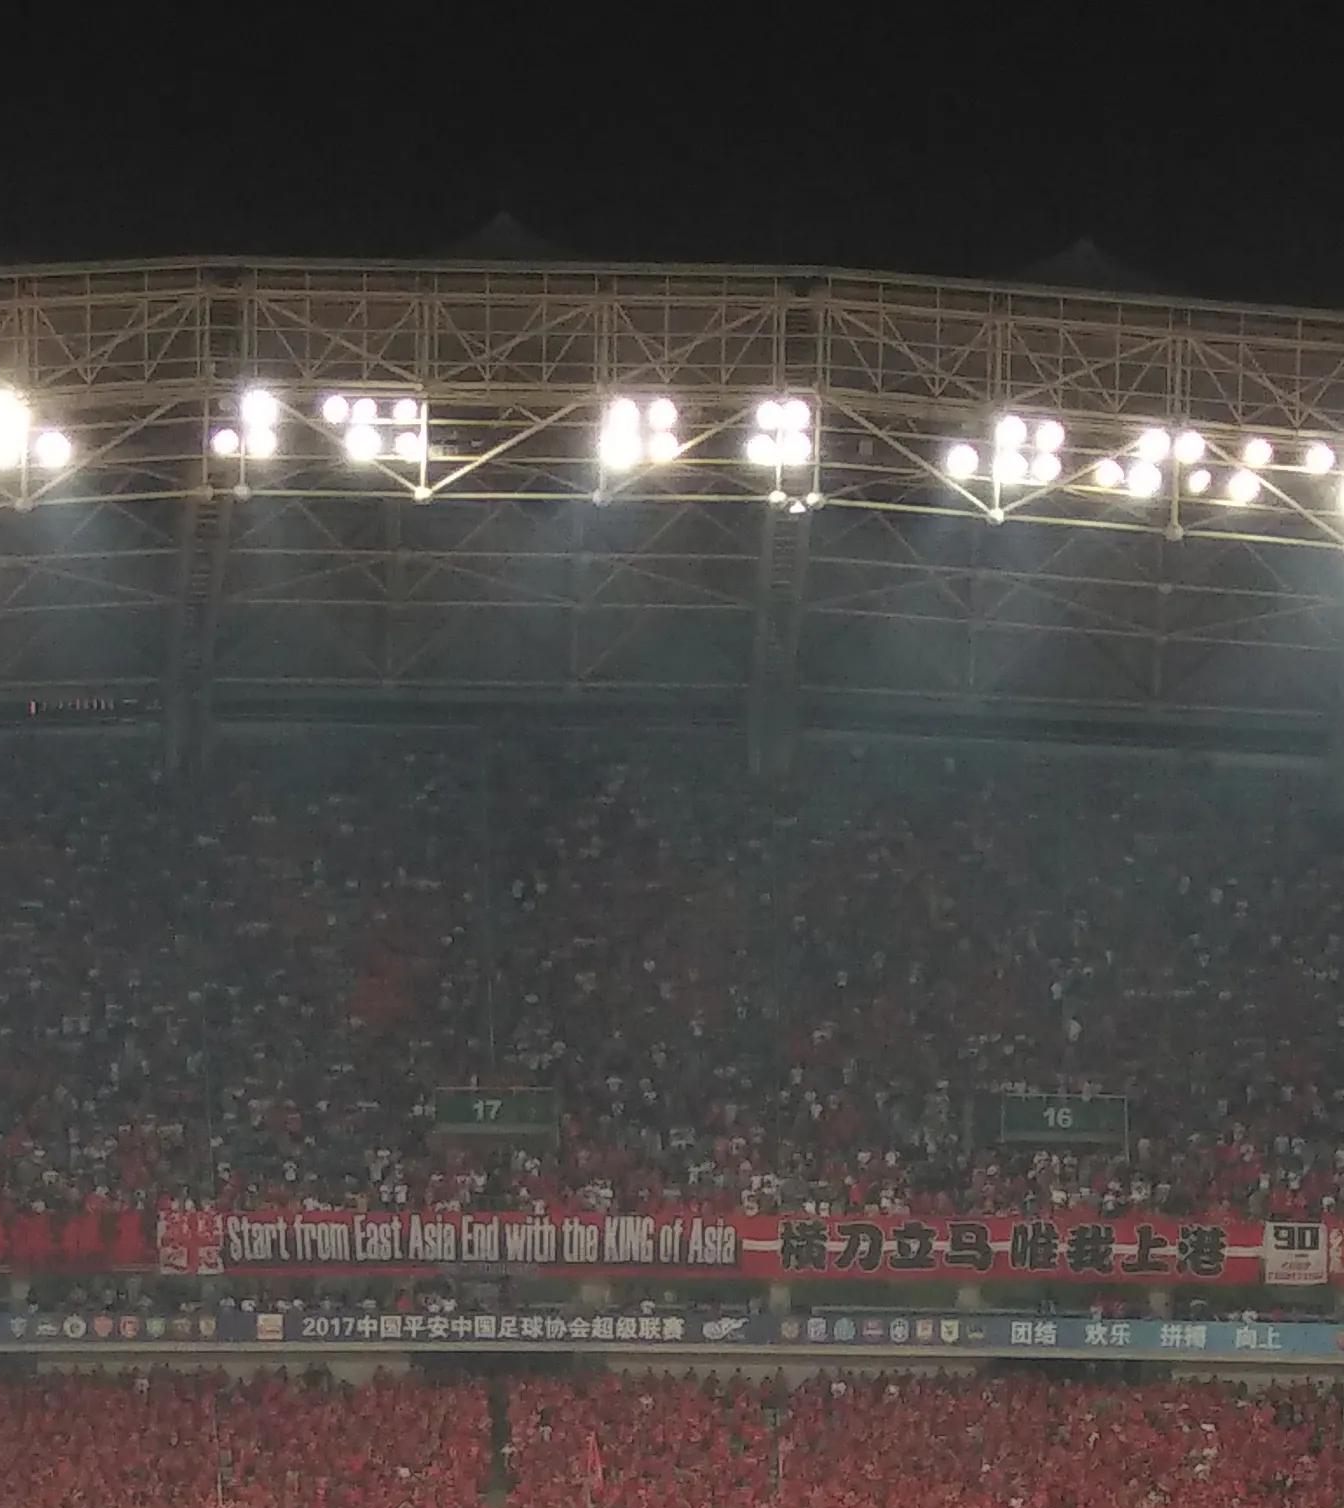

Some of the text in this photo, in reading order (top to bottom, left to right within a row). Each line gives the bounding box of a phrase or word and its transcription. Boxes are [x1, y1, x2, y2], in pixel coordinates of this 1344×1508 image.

[472, 1100, 500, 1120] 17
[1043, 1108, 1072, 1127] 16
[227, 1215, 290, 1262] Start
[293, 1215, 352, 1262] from
[354, 1214, 404, 1262] East
[408, 1215, 456, 1262] Asia
[460, 1214, 499, 1263] End
[503, 1214, 557, 1263] with
[562, 1215, 599, 1264] the
[603, 1214, 655, 1265] KING
[659, 1214, 685, 1265] of
[687, 1215, 737, 1265] Asia
[777, 1218, 1228, 1276] 横刀立马 唯我上港
[1011, 1320, 1057, 1346] 团结
[1084, 1321, 1131, 1347] 欢乐
[1235, 1324, 1282, 1351] 向上
